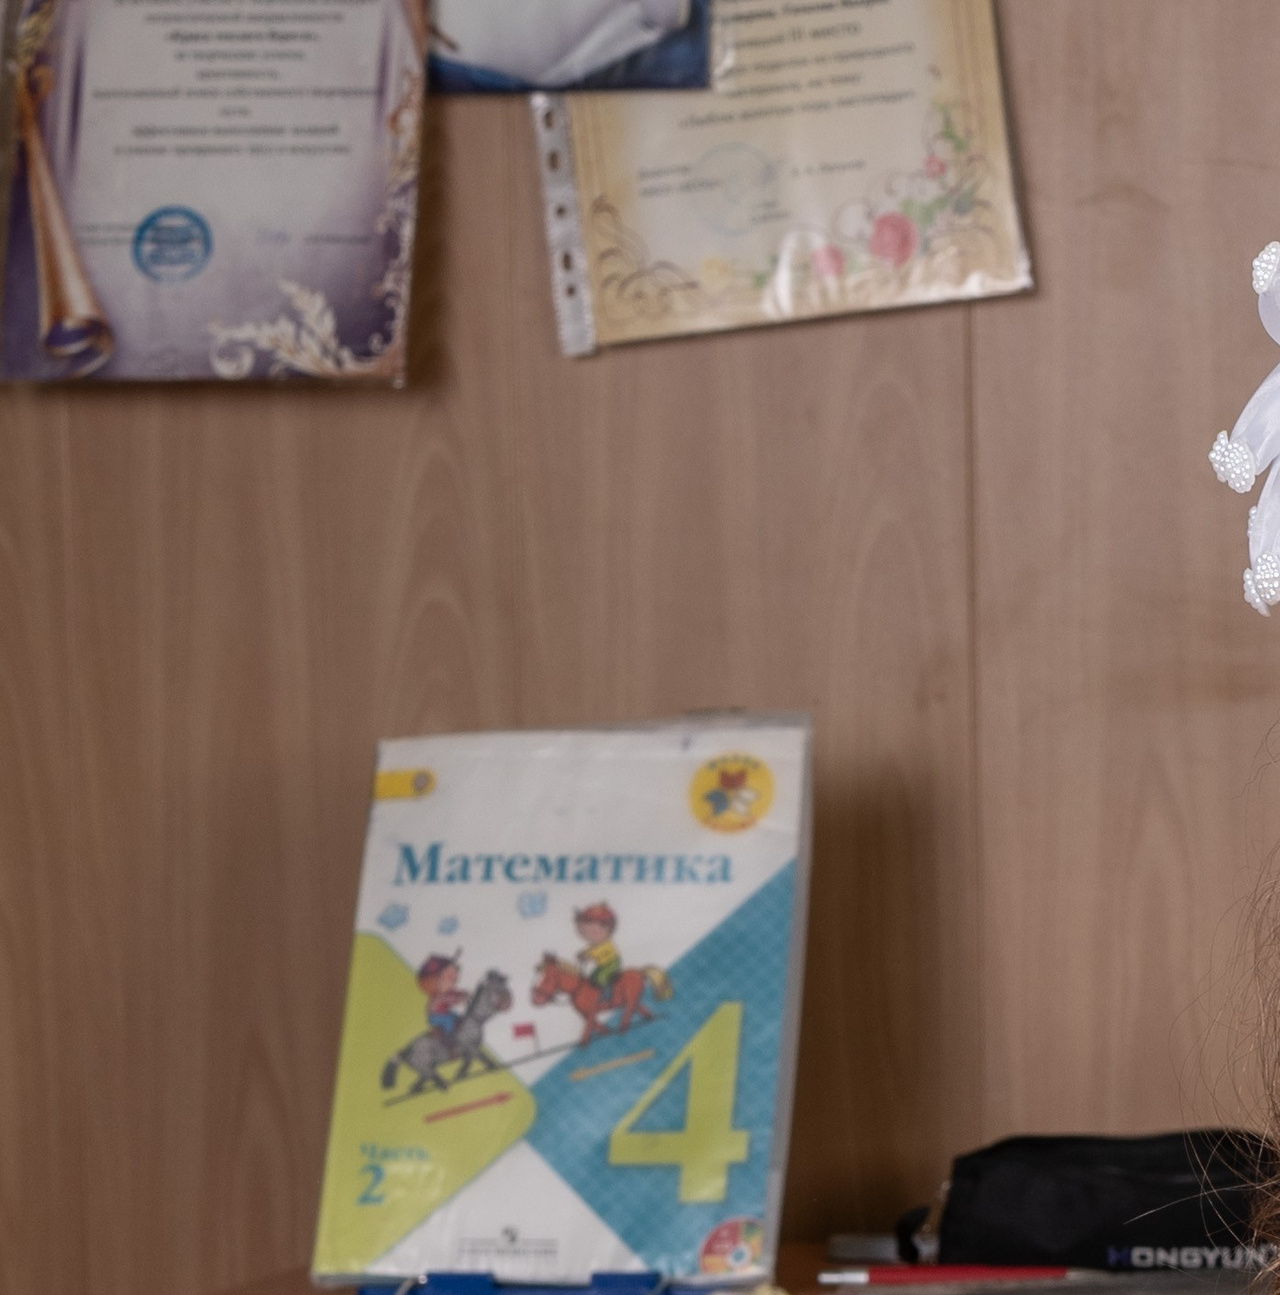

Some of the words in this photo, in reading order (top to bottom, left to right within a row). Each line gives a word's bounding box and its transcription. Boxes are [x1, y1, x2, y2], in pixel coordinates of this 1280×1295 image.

[394, 840, 733, 888] Математика
[608, 1002, 750, 1203] 4
[356, 1163, 385, 1205] 2
